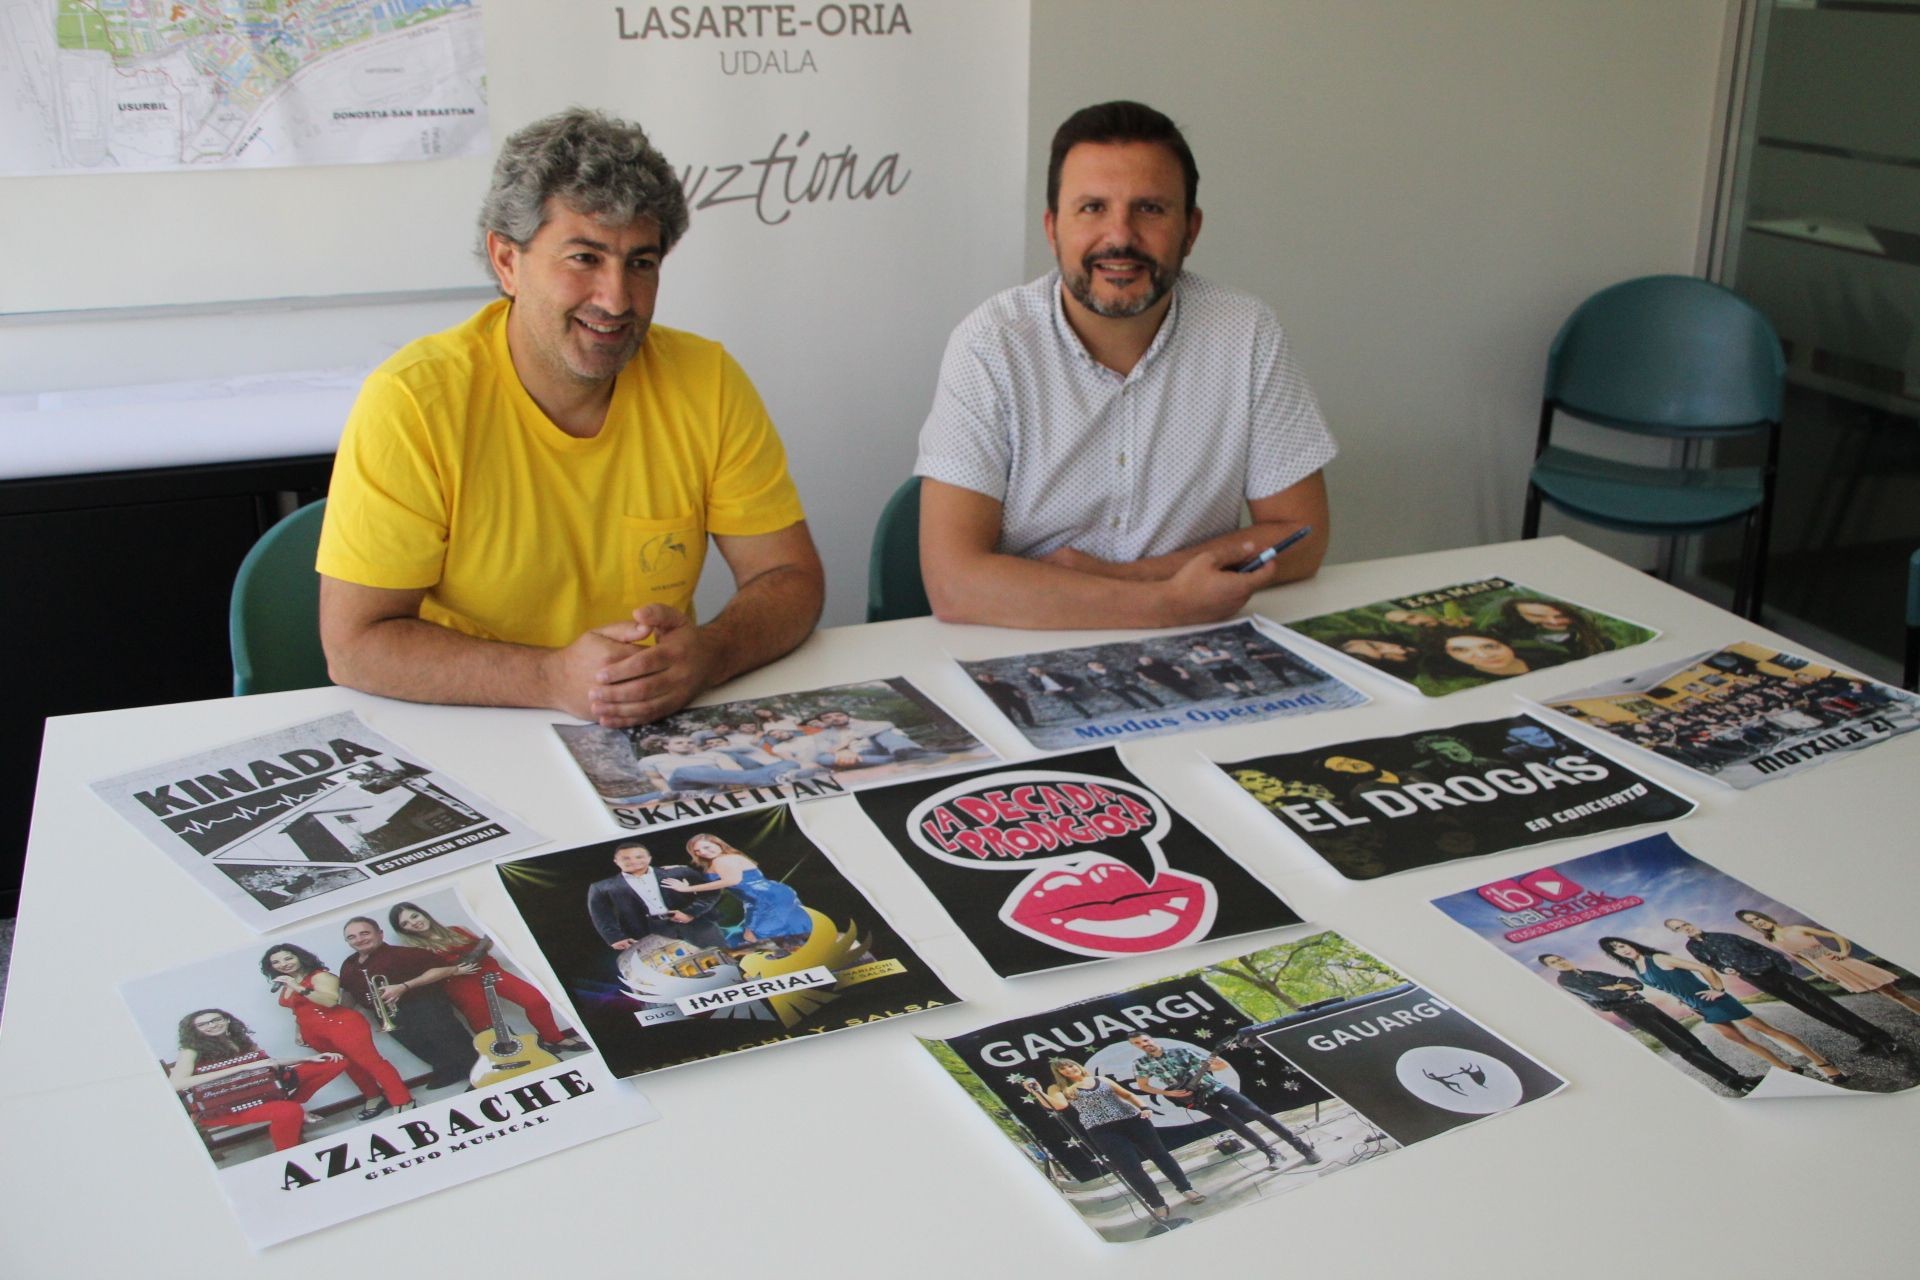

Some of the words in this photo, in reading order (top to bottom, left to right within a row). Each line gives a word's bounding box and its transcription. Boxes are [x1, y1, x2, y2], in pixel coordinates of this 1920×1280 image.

[616, 4, 911, 39] LASARTE-ORIA
[719, 50, 818, 75] UDALA
[118, 102, 168, 112] USURBIL
[416, 107, 475, 117] SEBASTIAN
[682, 131, 911, 226] uztiona
[1073, 715, 1179, 740] Modus
[1185, 692, 1327, 722] Operandi
[1749, 727, 1869, 774] MOTXILA
[1862, 715, 1898, 733] 21
[132, 737, 384, 818] KINADA
[1283, 801, 1371, 833] EL
[1359, 754, 1610, 819] DROGAS
[921, 806, 967, 852] LA
[953, 782, 1117, 826] DECADA
[954, 794, 1152, 859] PRODIGIOSA
[1524, 817, 1552, 832] EN
[1552, 782, 1649, 823] CONCIERTO
[375, 841, 456, 872] ESTIMULUEN
[454, 827, 502, 846] BIDAIA
[1485, 886, 1534, 910] ib
[644, 1009, 676, 1022] DUO
[689, 972, 825, 1011] IMPERIAL
[844, 1000, 945, 1027] SALSA
[978, 991, 1214, 1069] GAUARGI
[1307, 998, 1450, 1051] GAUARGI
[280, 1068, 596, 1191] AZABACHE
[365, 1151, 442, 1180] GRUPO
[449, 1115, 550, 1153] MUSICAL
